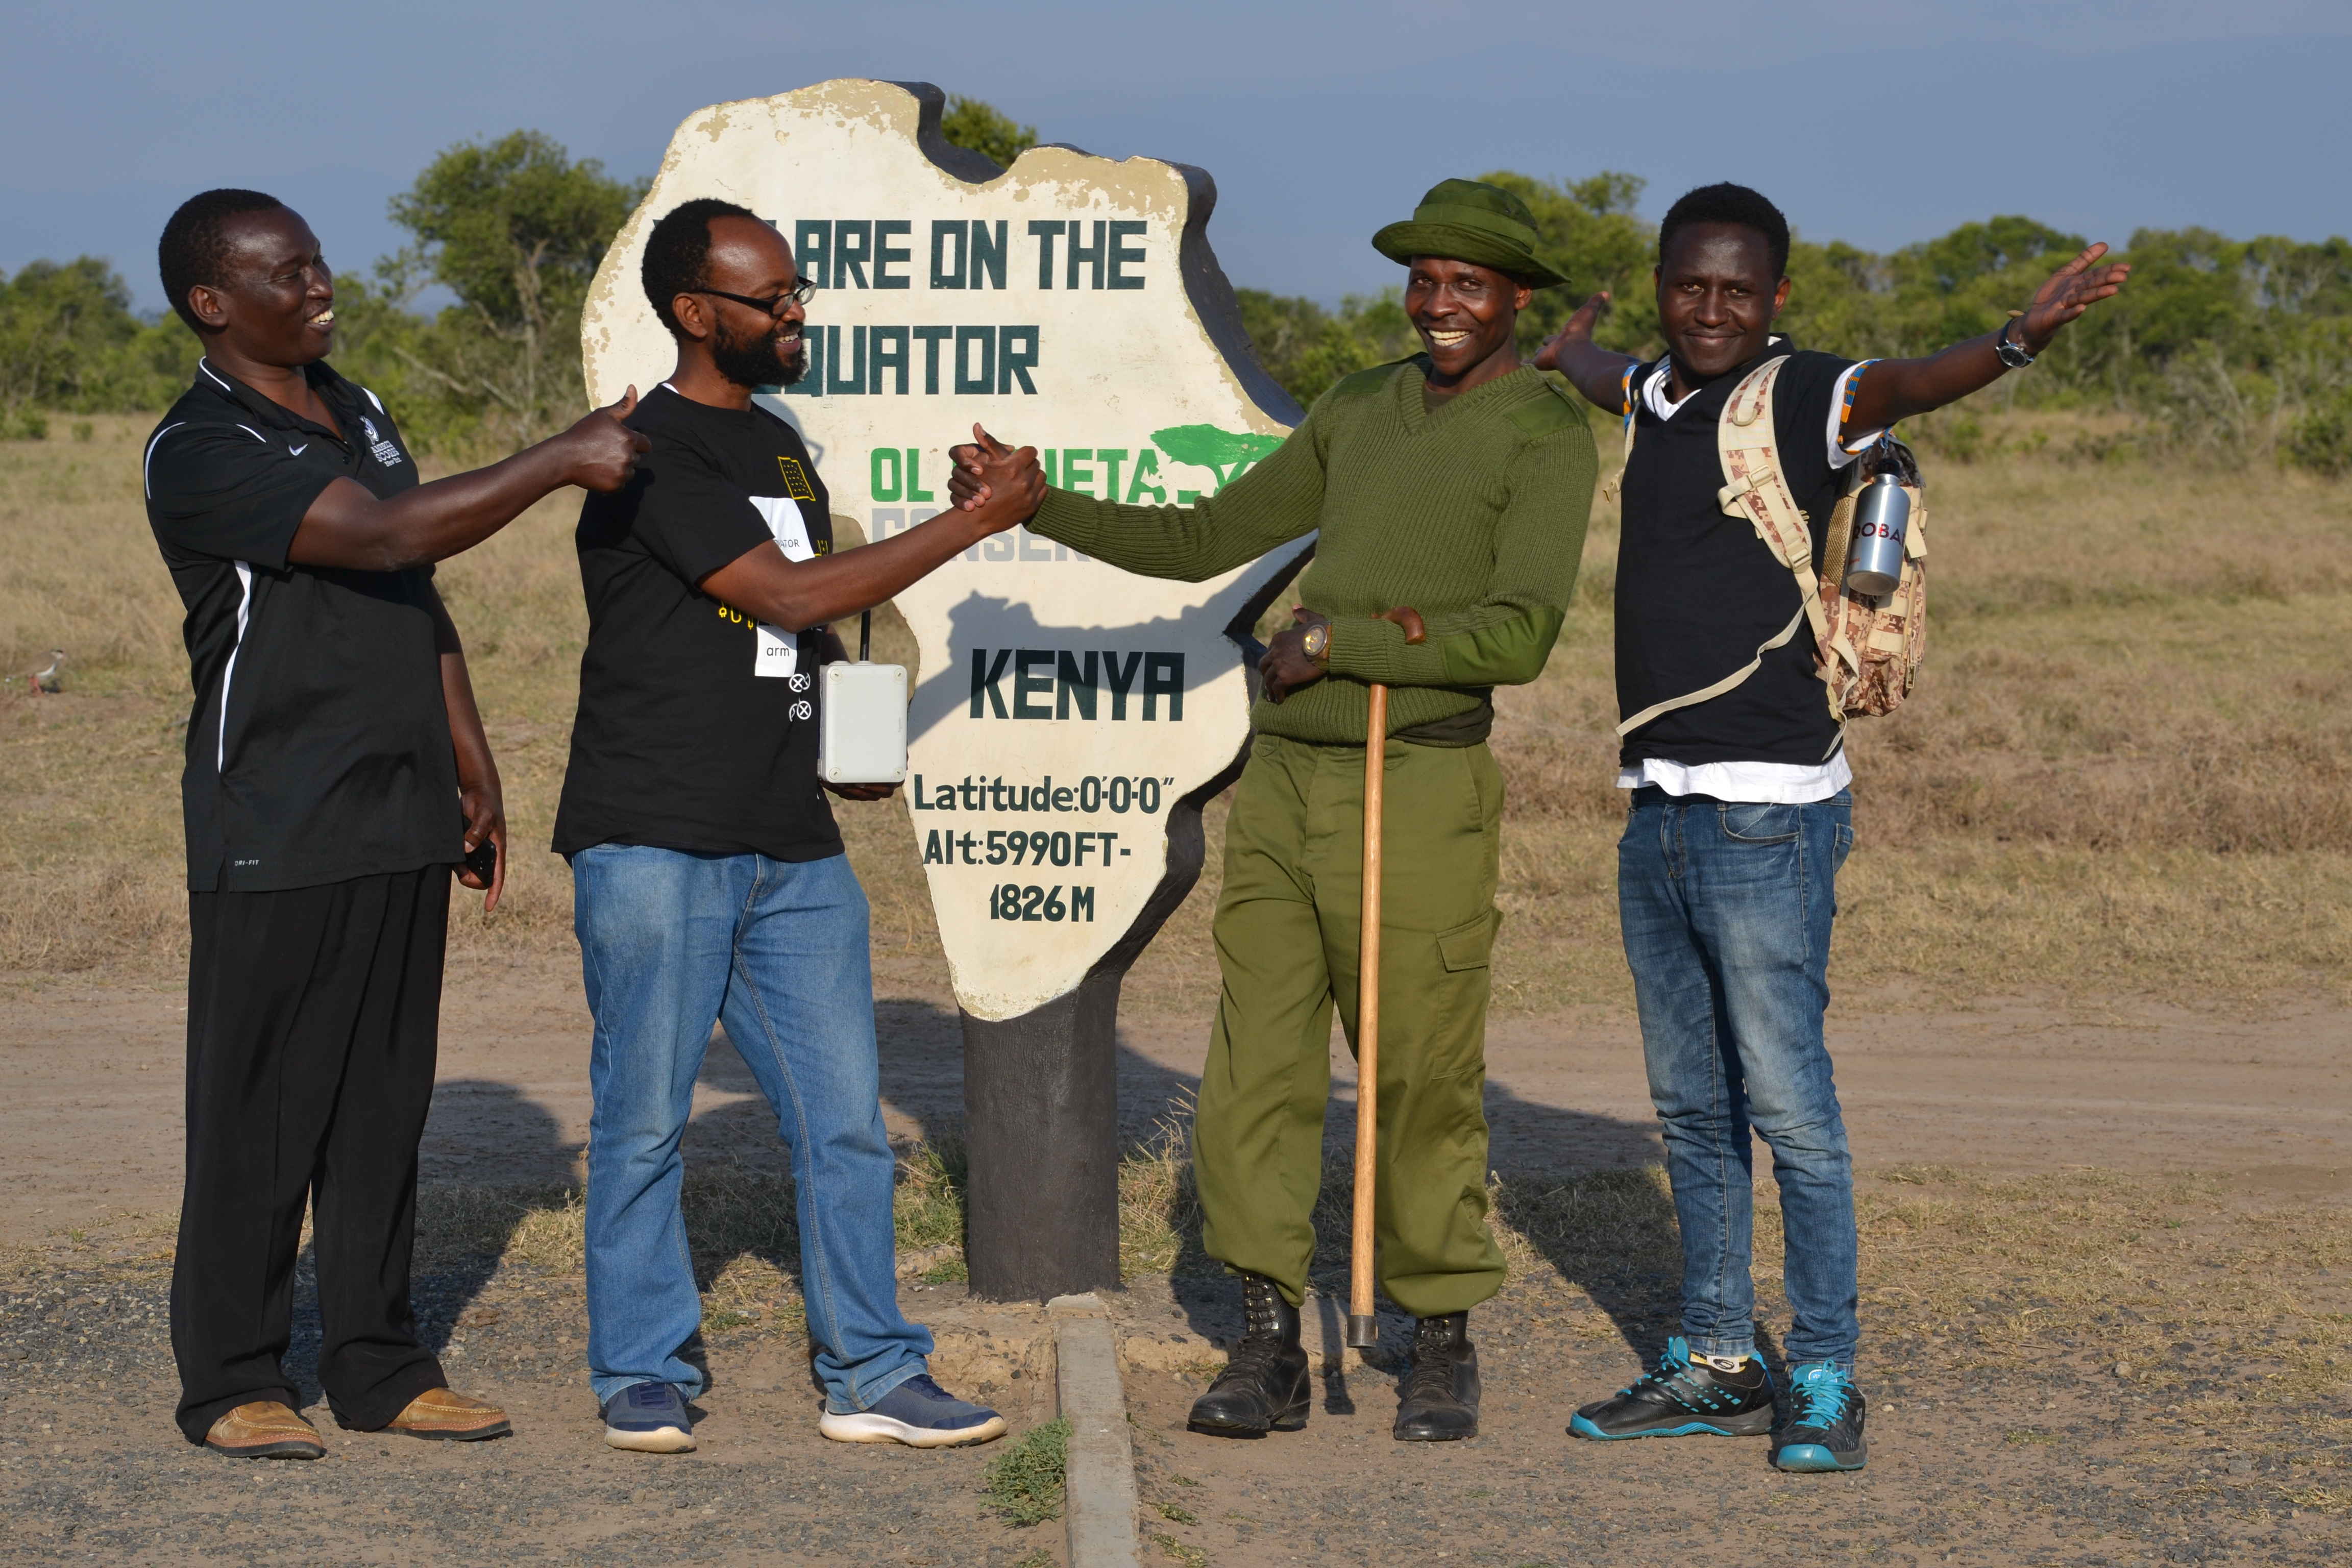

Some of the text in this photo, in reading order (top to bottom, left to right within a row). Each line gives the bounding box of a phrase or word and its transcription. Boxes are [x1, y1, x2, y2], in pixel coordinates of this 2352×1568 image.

[795, 220, 1147, 290] ARE ON THE
[871, 448, 934, 502] OL
[767, 647, 790, 657] arm
[970, 648, 1185, 721] KENYA
